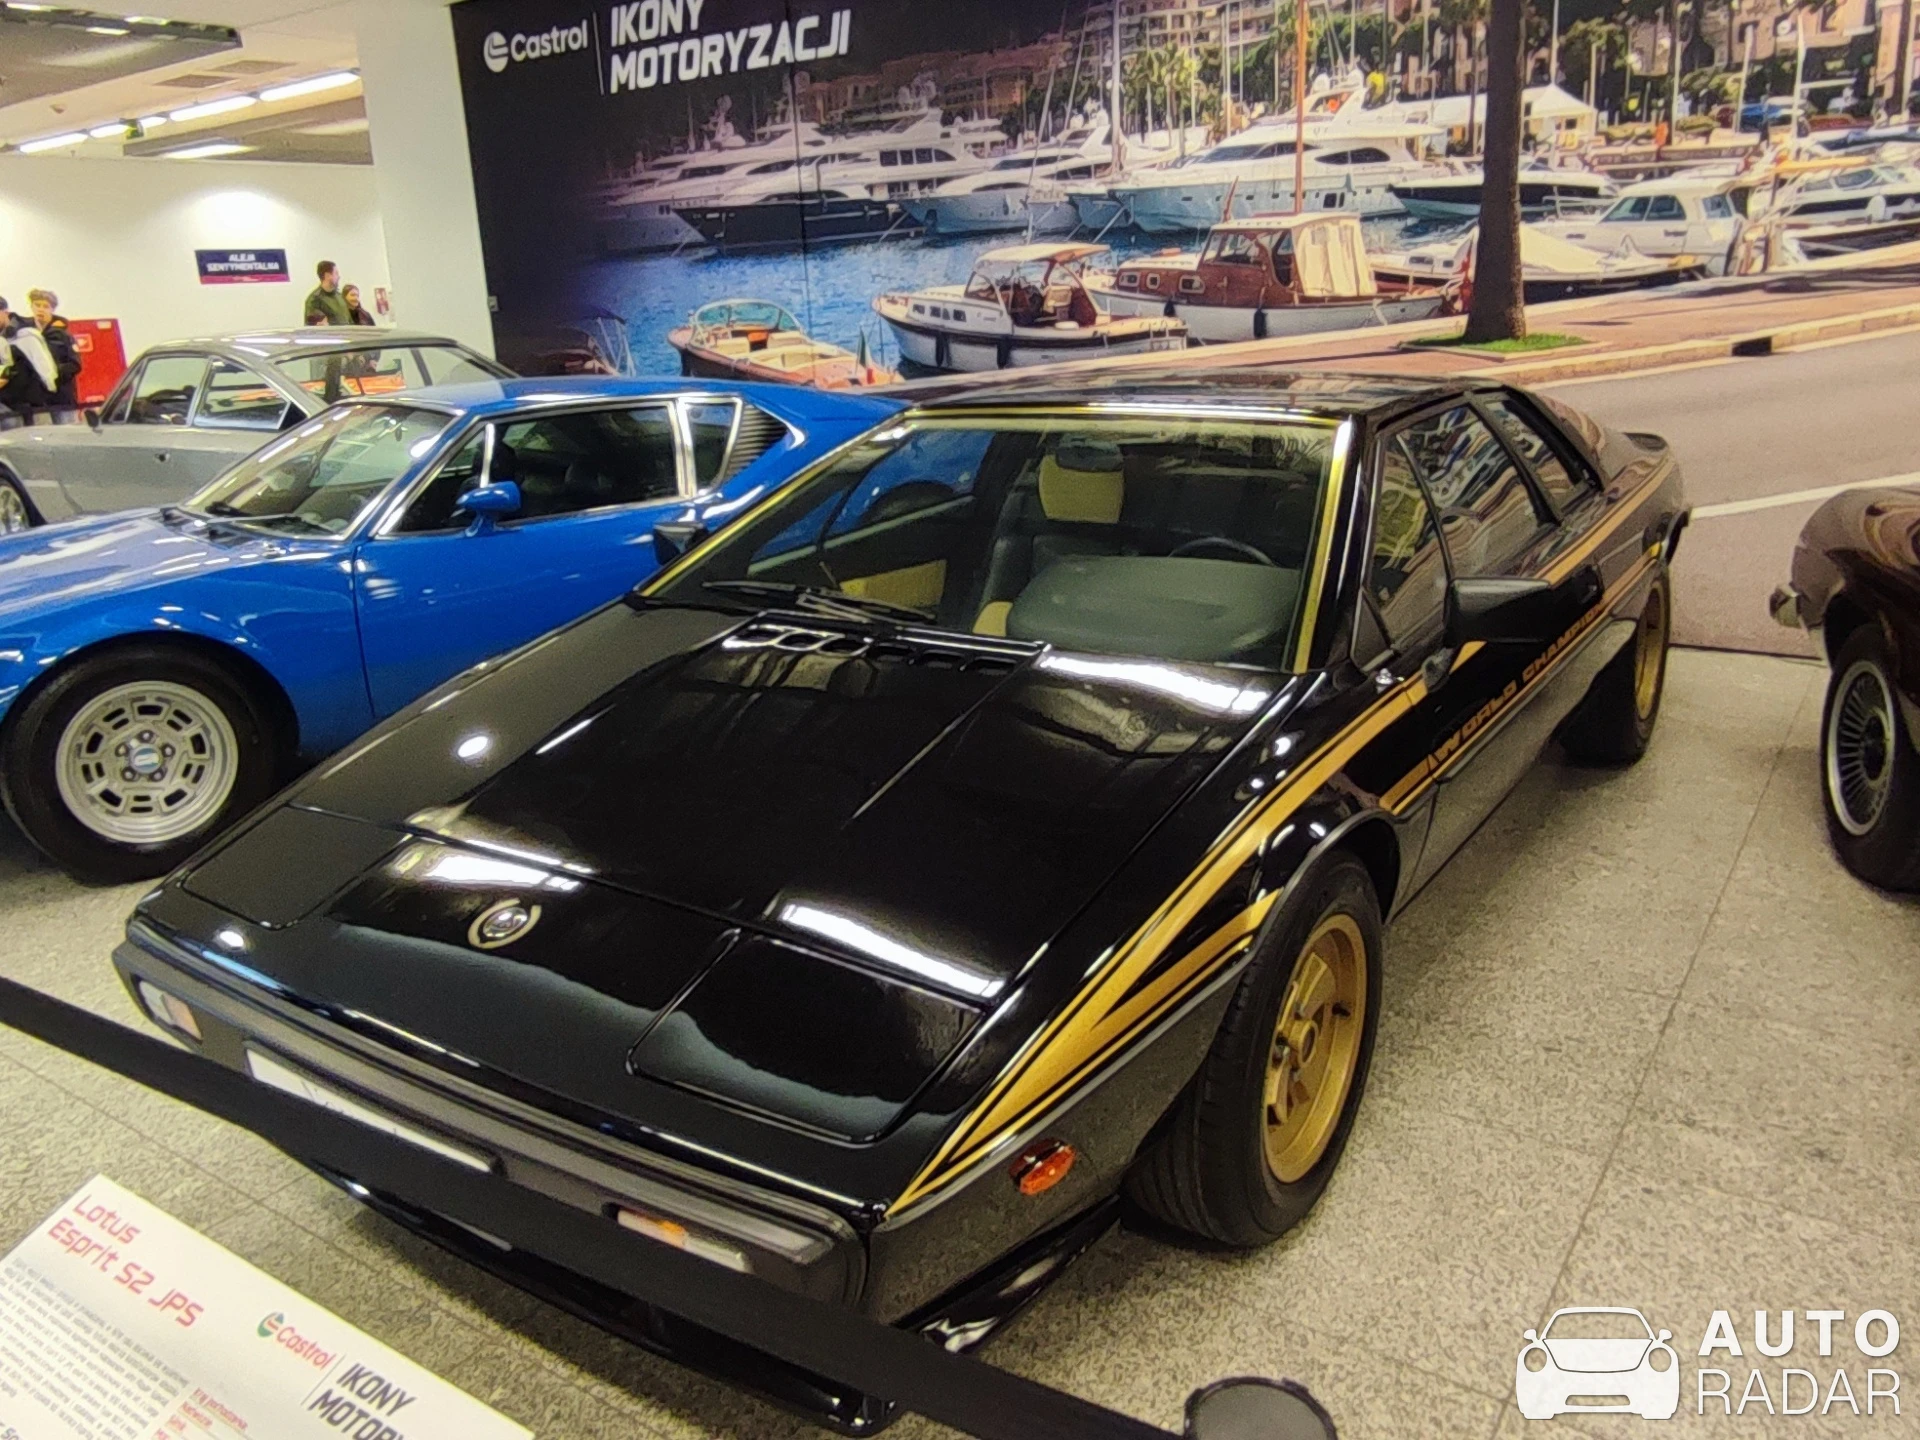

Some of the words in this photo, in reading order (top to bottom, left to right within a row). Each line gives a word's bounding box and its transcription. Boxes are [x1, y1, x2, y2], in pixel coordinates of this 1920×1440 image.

[511, 20, 588, 62] Castrol
[611, 0, 702, 47] IKONY
[610, 10, 852, 93] MOTORYZACJI
[72, 1194, 142, 1244] Lotus
[48, 1217, 120, 1272] Esprit
[113, 1262, 155, 1295] S2
[147, 1288, 204, 1328] JPS
[276, 1326, 337, 1370] Castrol
[307, 1388, 404, 1440] MOTOR
[336, 1363, 418, 1416] IKONY
